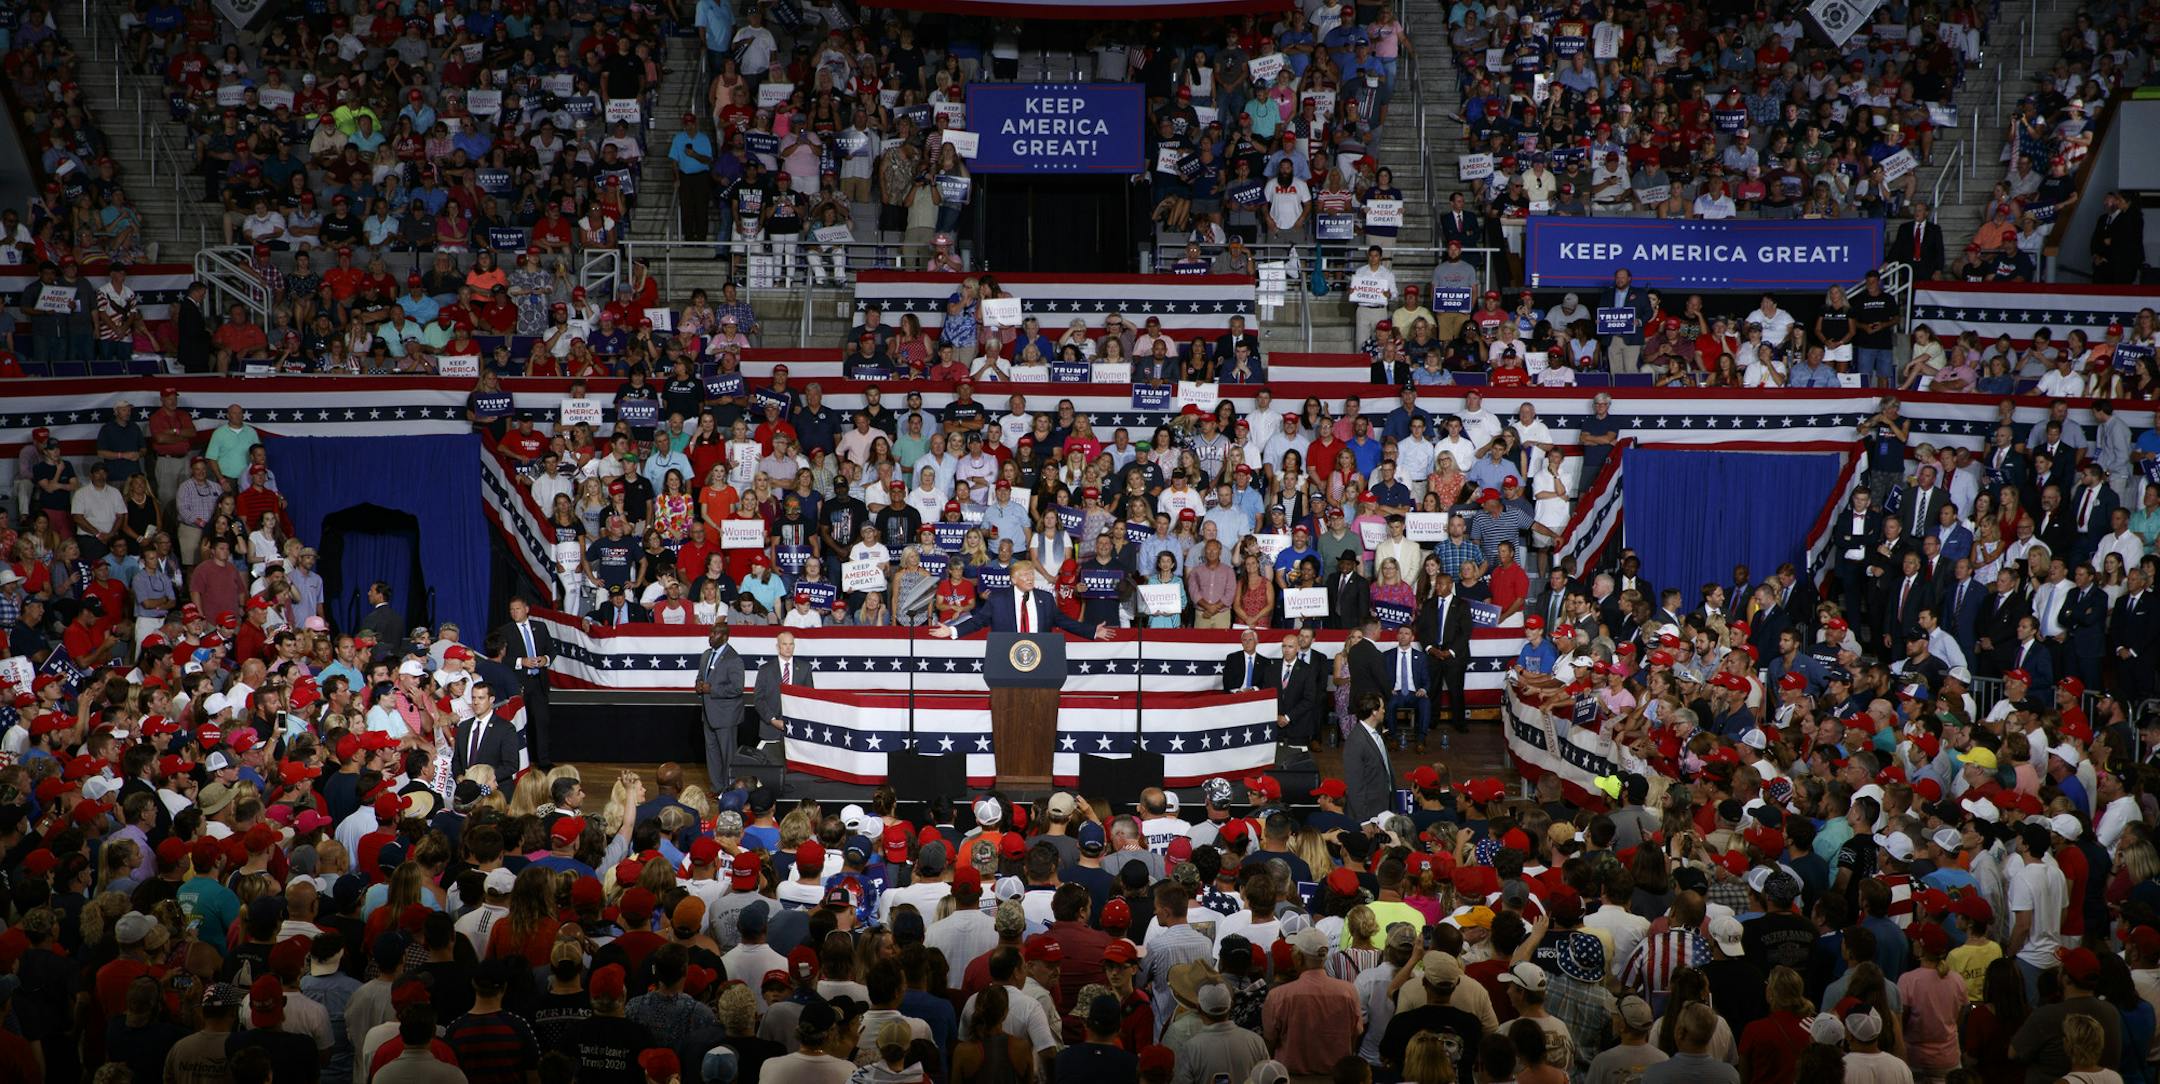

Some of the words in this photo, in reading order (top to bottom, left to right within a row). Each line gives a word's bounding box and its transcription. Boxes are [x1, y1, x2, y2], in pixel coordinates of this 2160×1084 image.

[1253, 63, 1283, 74] AMERICA
[1025, 98, 1085, 113] KEEP
[1001, 119, 1109, 135] AMERICA
[746, 137, 778, 145] TRUMP
[1013, 139, 1097, 156] GREAT!
[1180, 158, 1200, 171] TRUMP
[1462, 162, 1492, 170] AMERICA
[1886, 156, 1901, 167] KEEP
[1233, 186, 1262, 200] TRUMP
[1559, 243, 1623, 261] KEEP
[1633, 244, 1748, 263] AMERICA
[1758, 245, 1850, 264] GREAT!
[1353, 286, 1385, 294] AMERICA
[41, 295, 72, 303] AMERICA
[984, 303, 1018, 316] Women
[1013, 374, 1047, 383] Women
[1094, 371, 1128, 380] Women
[706, 378, 740, 390] TRUMP
[1134, 389, 1170, 397] TRUMP
[1180, 389, 1215, 398] Women
[745, 446, 755, 482] Women
[724, 527, 762, 537] Women
[852, 563, 870, 571] KEEP
[844, 569, 881, 580] AMERICA
[796, 587, 834, 596] TRUMP
[1143, 592, 1178, 602] Women
[1287, 595, 1325, 606] Women
[1376, 606, 1411, 617] TRUMP
[1812, 653, 1837, 662] TRUMP
[1146, 833, 1174, 844] TRUMP
[536, 1009, 560, 1018] OUR
[561, 1007, 592, 1017] FLAG
[179, 1061, 227, 1073] National
[604, 1059, 626, 1070] 2020
